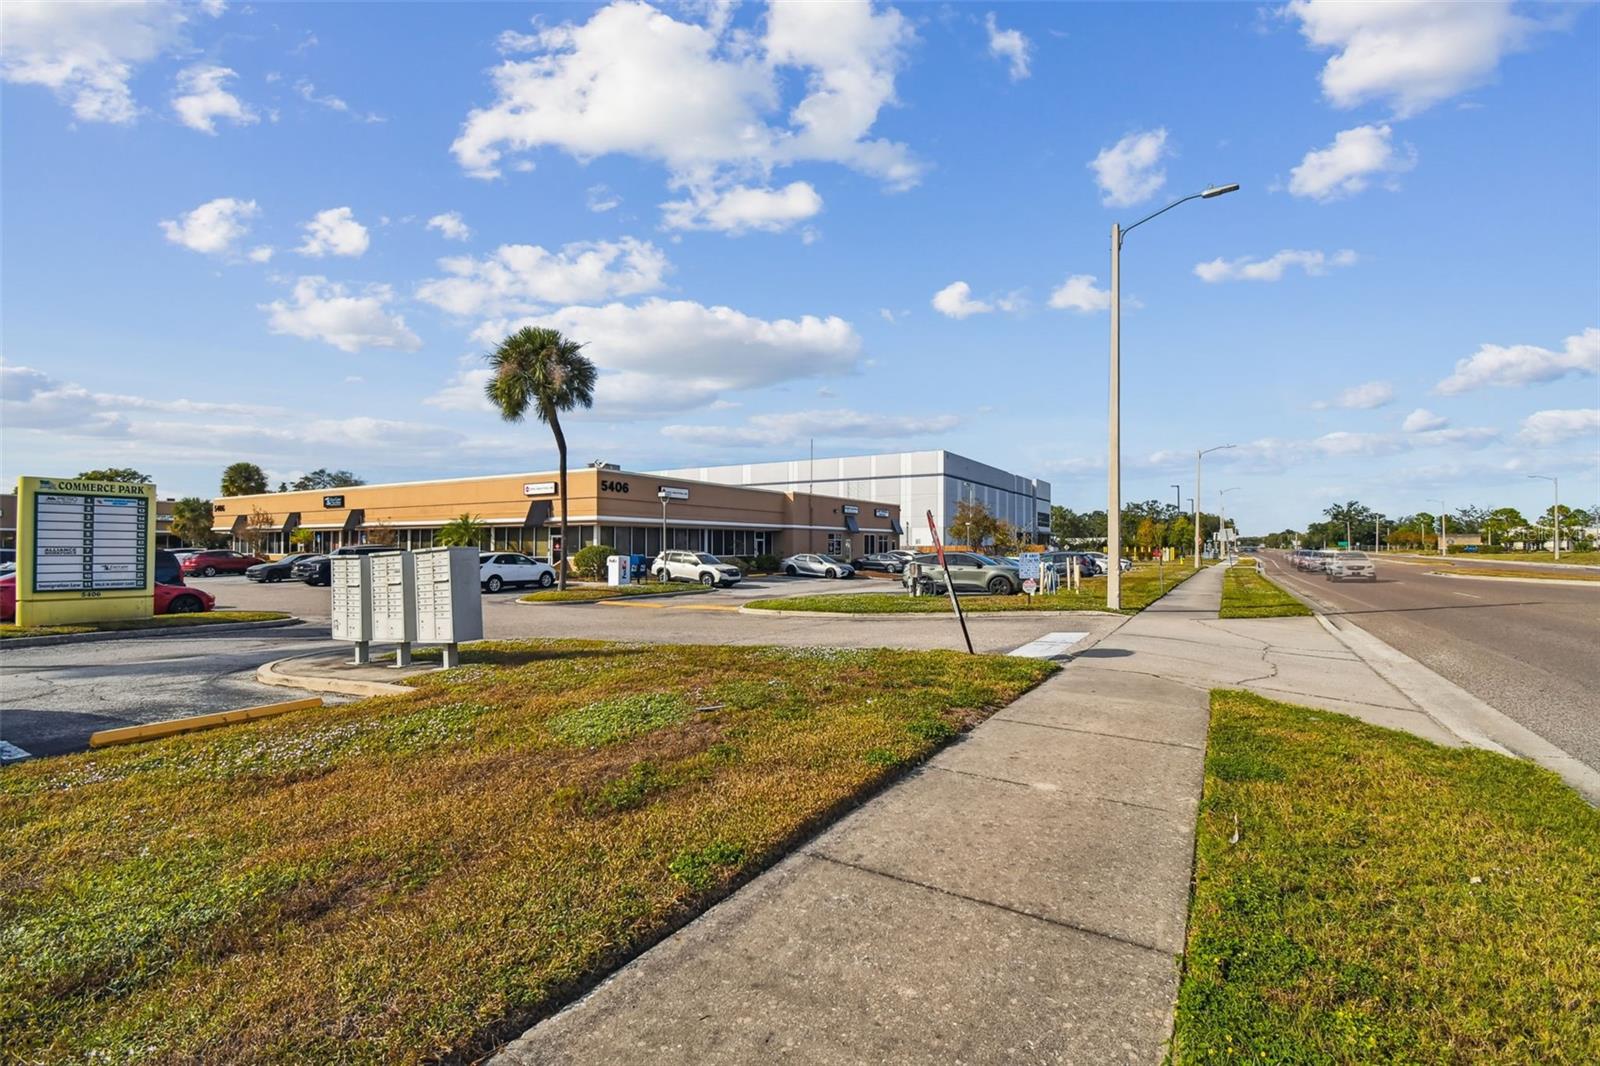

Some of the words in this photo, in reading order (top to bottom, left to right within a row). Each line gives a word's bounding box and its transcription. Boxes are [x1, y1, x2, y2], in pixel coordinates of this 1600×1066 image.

[58, 481, 116, 493] COMMERCE
[118, 483, 145, 495] PARK
[601, 480, 629, 494] 5406
